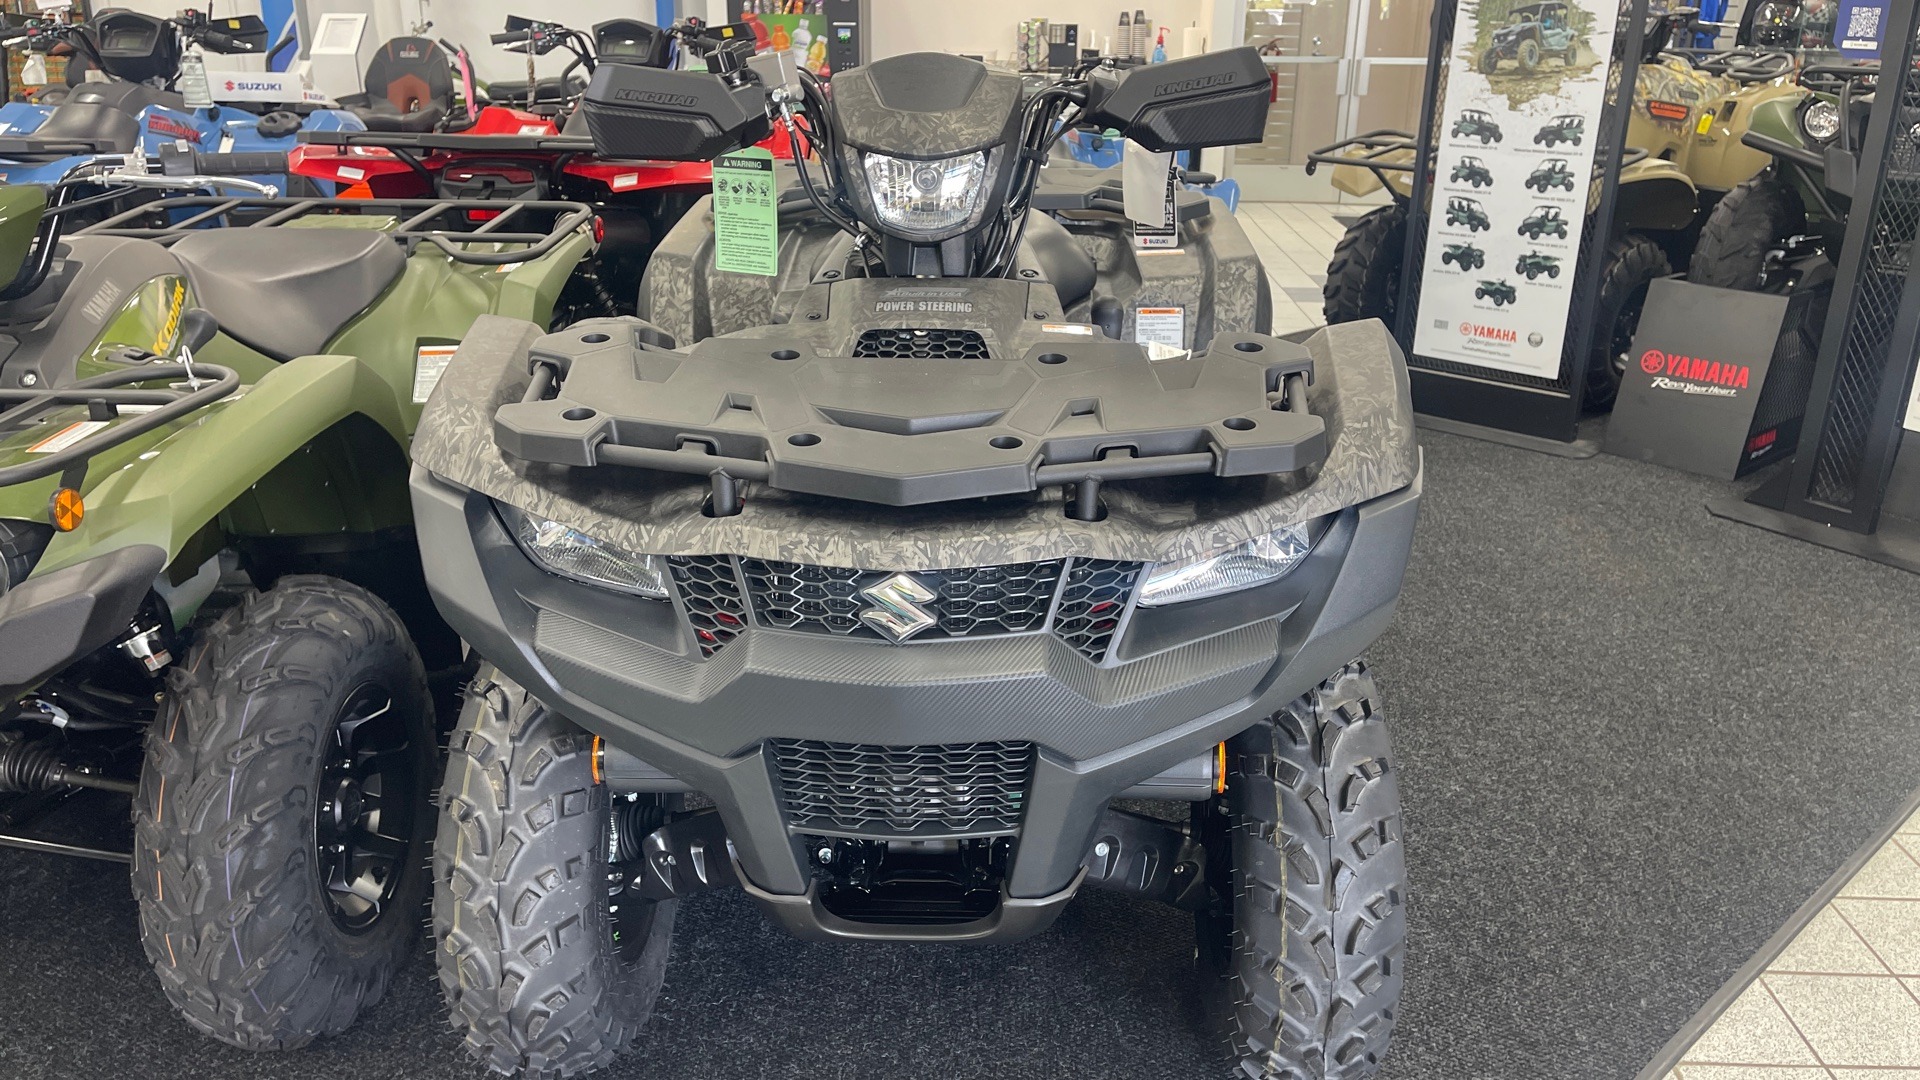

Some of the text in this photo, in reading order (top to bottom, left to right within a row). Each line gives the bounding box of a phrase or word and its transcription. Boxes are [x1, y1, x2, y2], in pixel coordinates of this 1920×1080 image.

[238, 82, 282, 91] SUZUKI
[1154, 72, 1237, 97] KINGQUAD
[615, 89, 699, 107] KINGQUAD
[730, 160, 762, 169] WARNING
[83, 280, 121, 320] YAMAHA
[875, 301, 973, 313] POWER STEERING
[1473, 325, 1517, 342] YAMAHA
[1666, 354, 1749, 389] YAMAHA
[1651, 377, 1737, 396] Revs Your Heart
